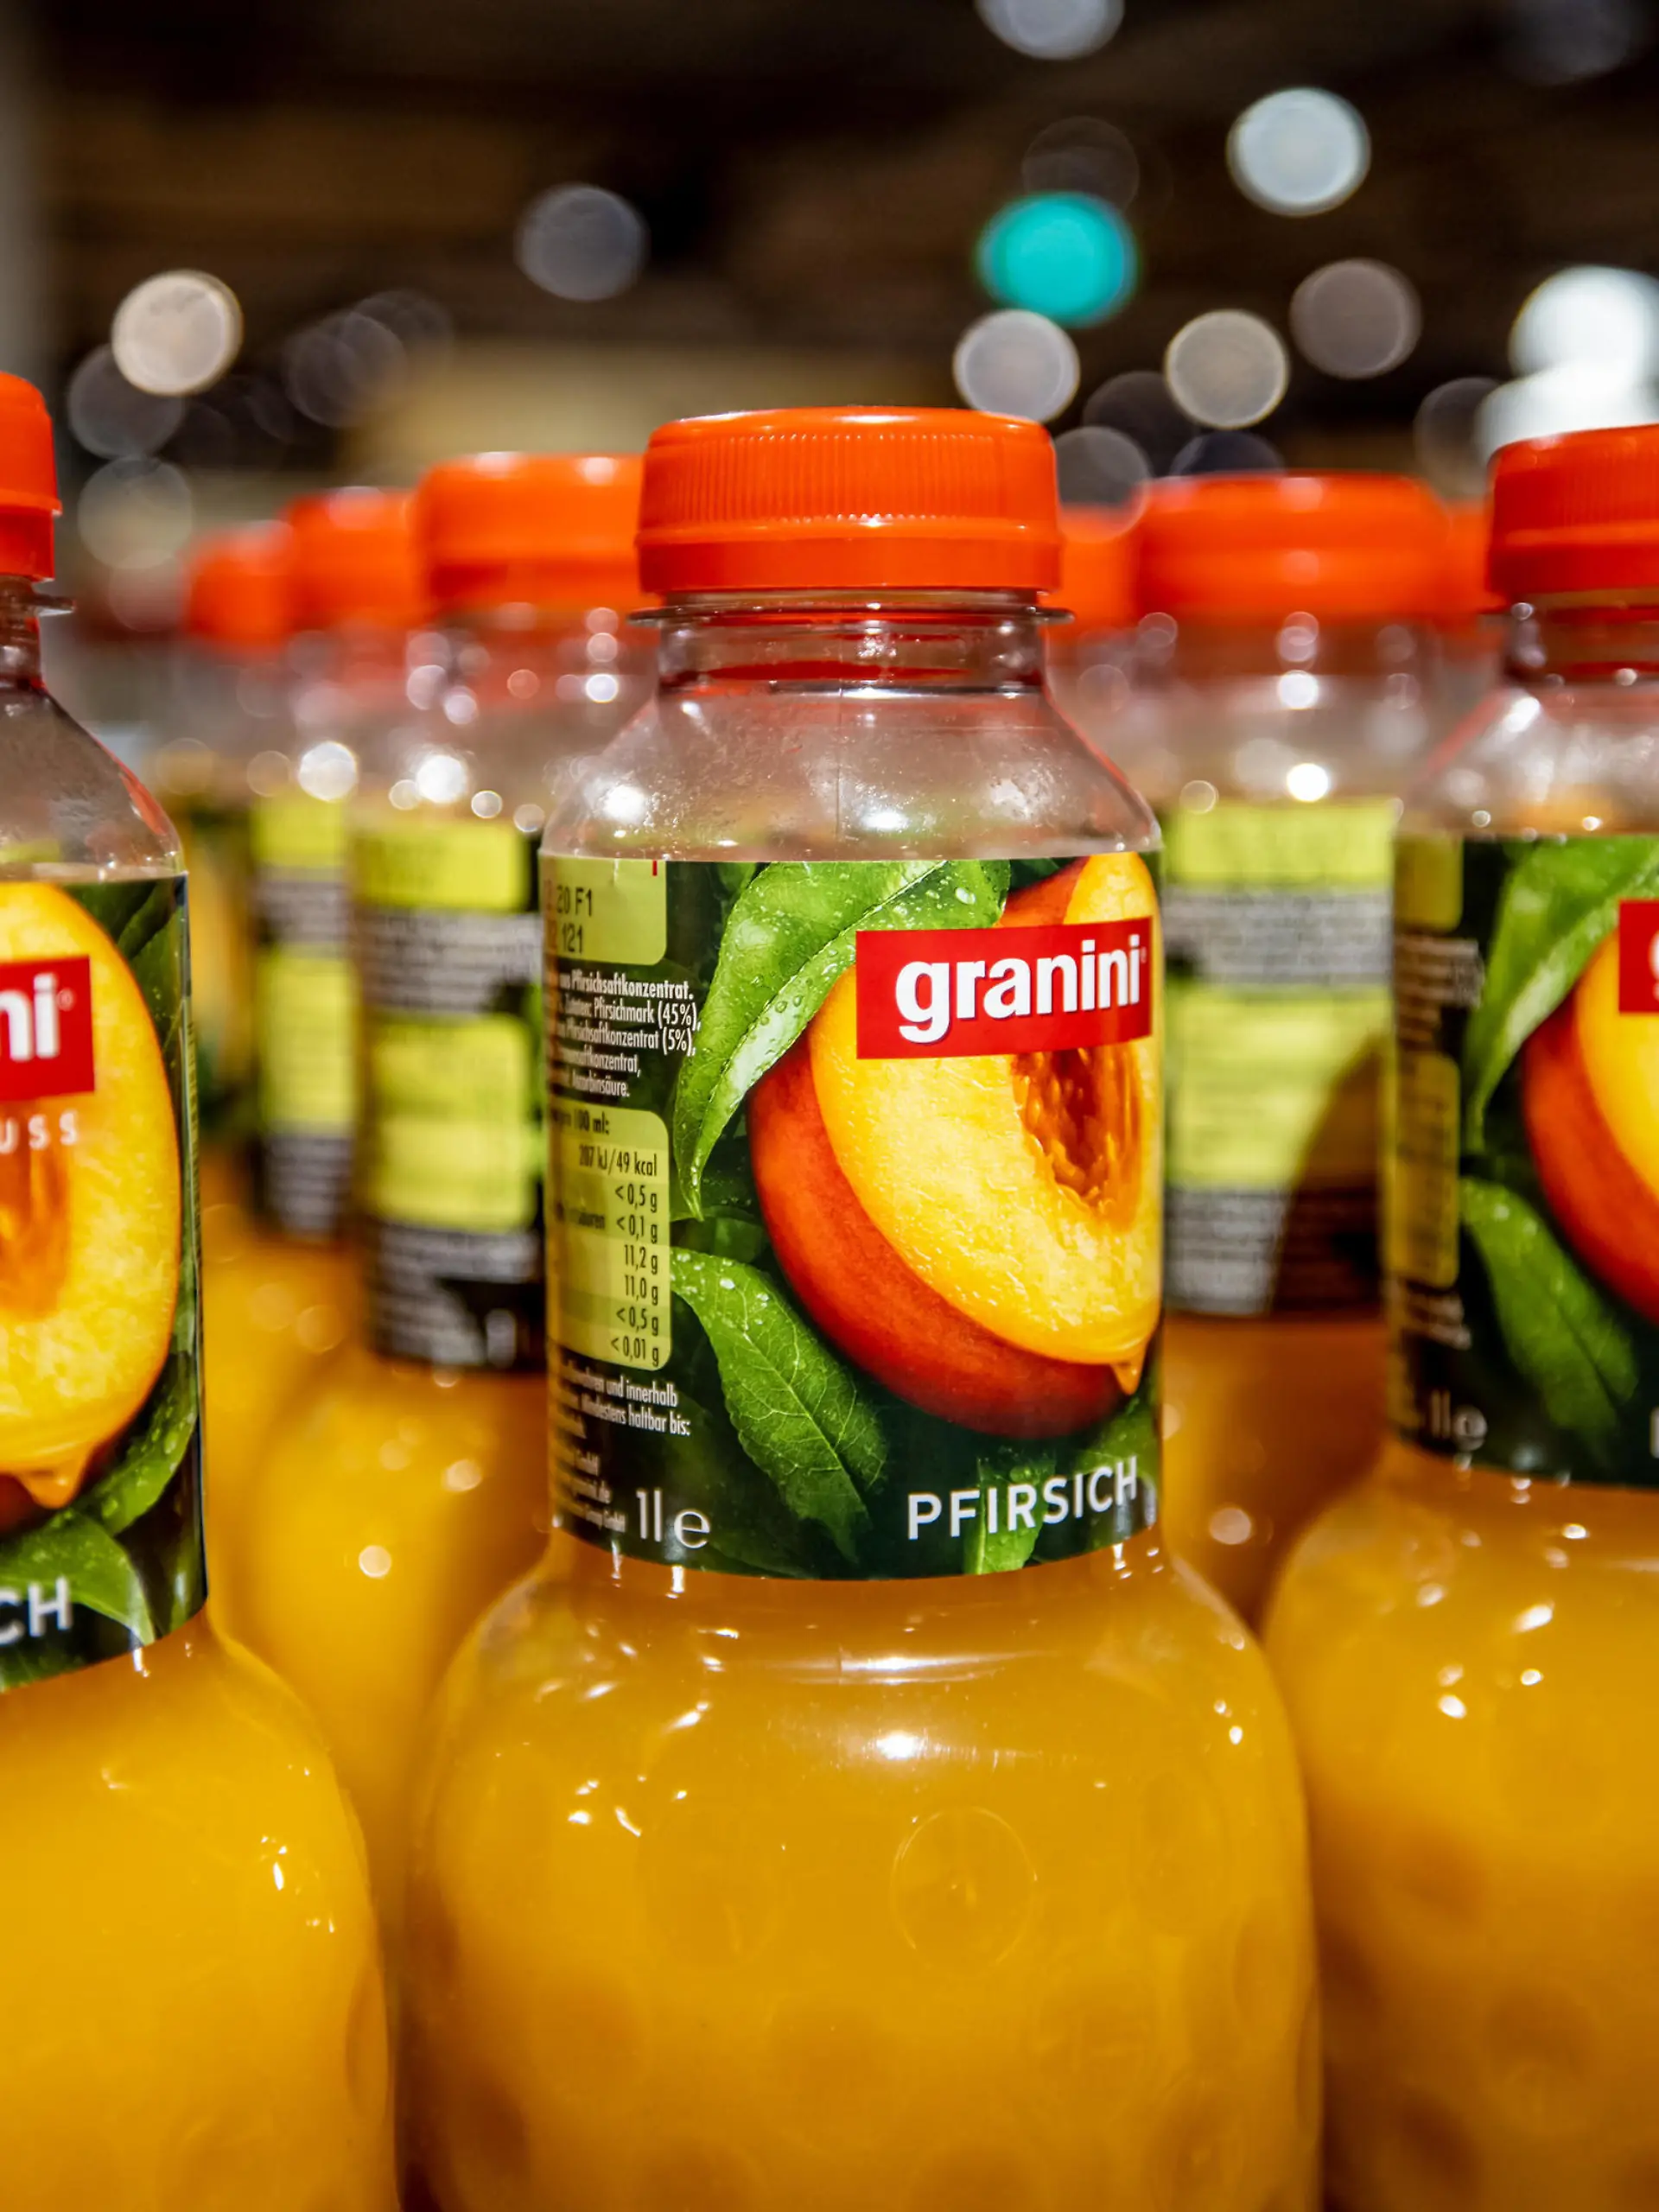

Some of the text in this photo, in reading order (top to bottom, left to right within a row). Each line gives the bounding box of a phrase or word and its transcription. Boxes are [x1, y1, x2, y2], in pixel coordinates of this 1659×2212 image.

[571, 969, 694, 1001] Pfirsichsaftkonzentrat.
[895, 934, 1141, 1044] granini
[594, 996, 654, 1024] Pfirsichmark
[658, 1001, 701, 1032] (45%),
[662, 1027, 696, 1057] (5%),
[634, 1152, 657, 1177] kcal
[624, 1244, 646, 1272] 11,2
[624, 1274, 647, 1302] 11,0
[626, 1380, 678, 1408] innerhalb
[628, 1403, 666, 1433] haltbar
[669, 1411, 690, 1437] bis:
[908, 1455, 1137, 1541] PFIRSICH
